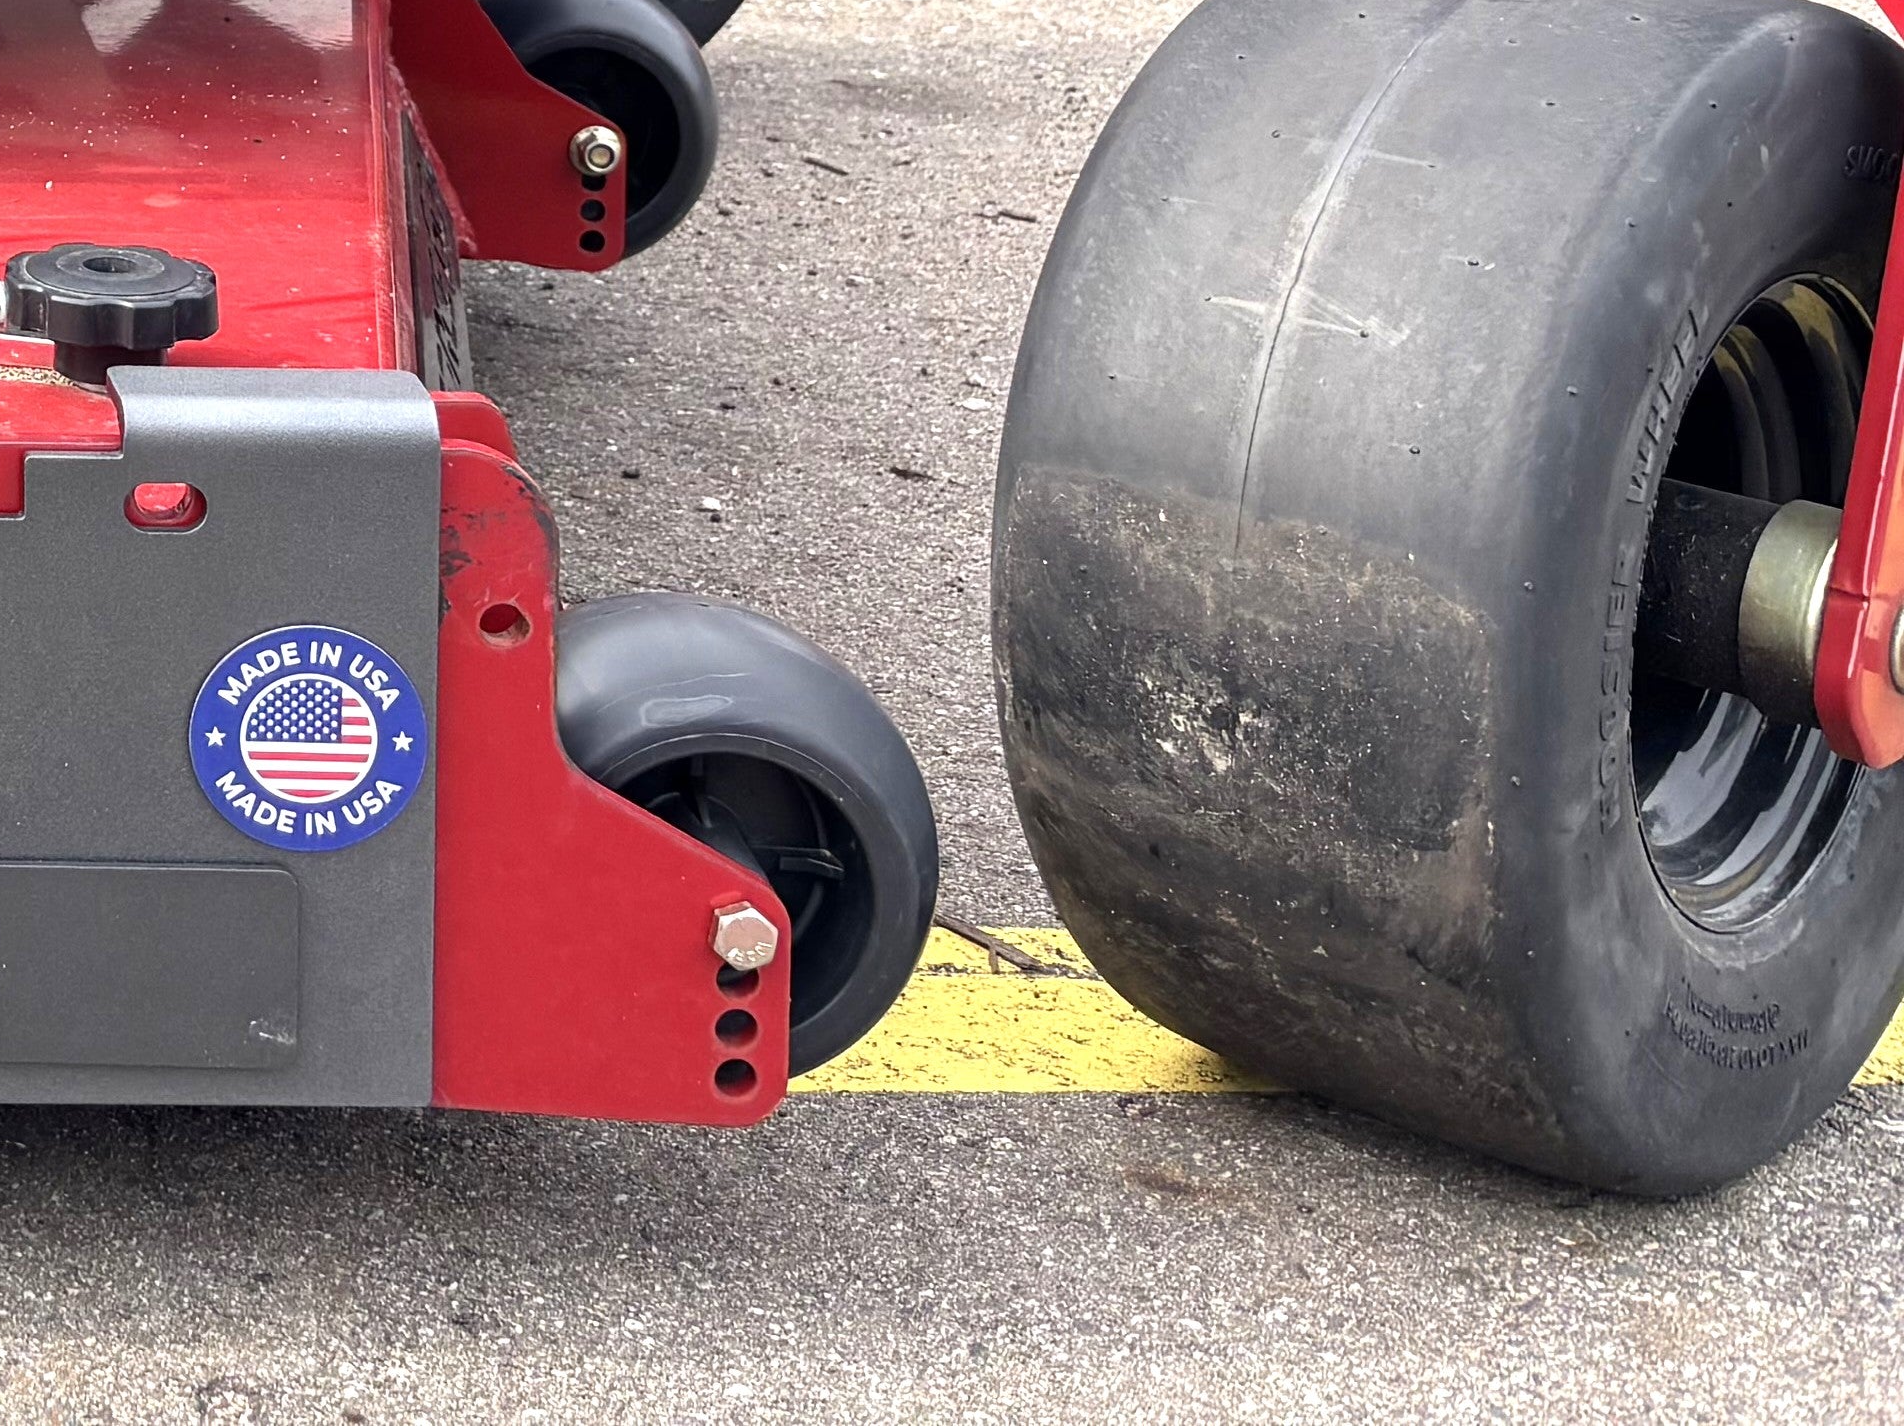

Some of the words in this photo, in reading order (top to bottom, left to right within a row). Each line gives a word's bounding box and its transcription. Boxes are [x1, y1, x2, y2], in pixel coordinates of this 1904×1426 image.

[217, 641, 302, 706] MADE
[309, 641, 343, 668] IN
[348, 653, 401, 712] USA
[214, 770, 298, 834] MADE
[304, 810, 337, 837] IN
[341, 779, 404, 826] USA
